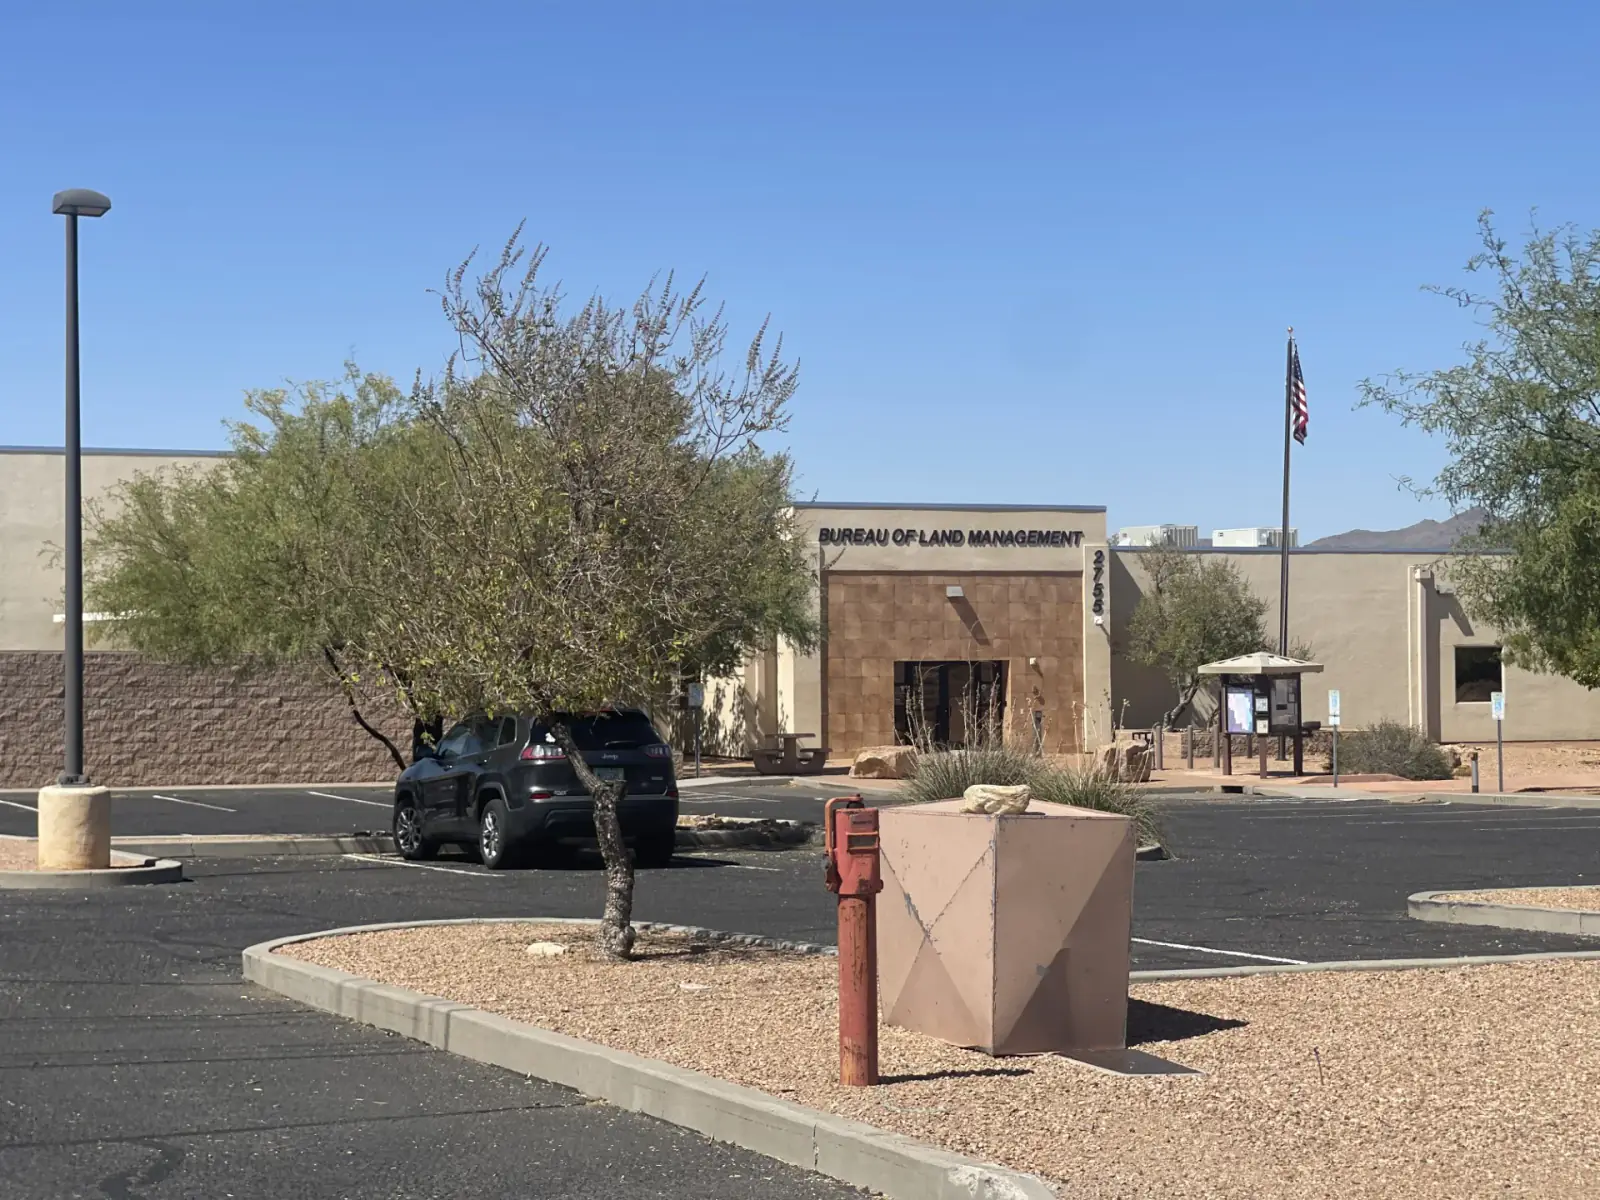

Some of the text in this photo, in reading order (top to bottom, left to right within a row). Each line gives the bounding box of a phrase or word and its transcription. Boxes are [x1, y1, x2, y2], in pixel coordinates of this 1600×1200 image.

[819, 527, 1084, 548] BUREAU OF LAND MANAGEMENT
[1092, 550, 1105, 615] 2755
